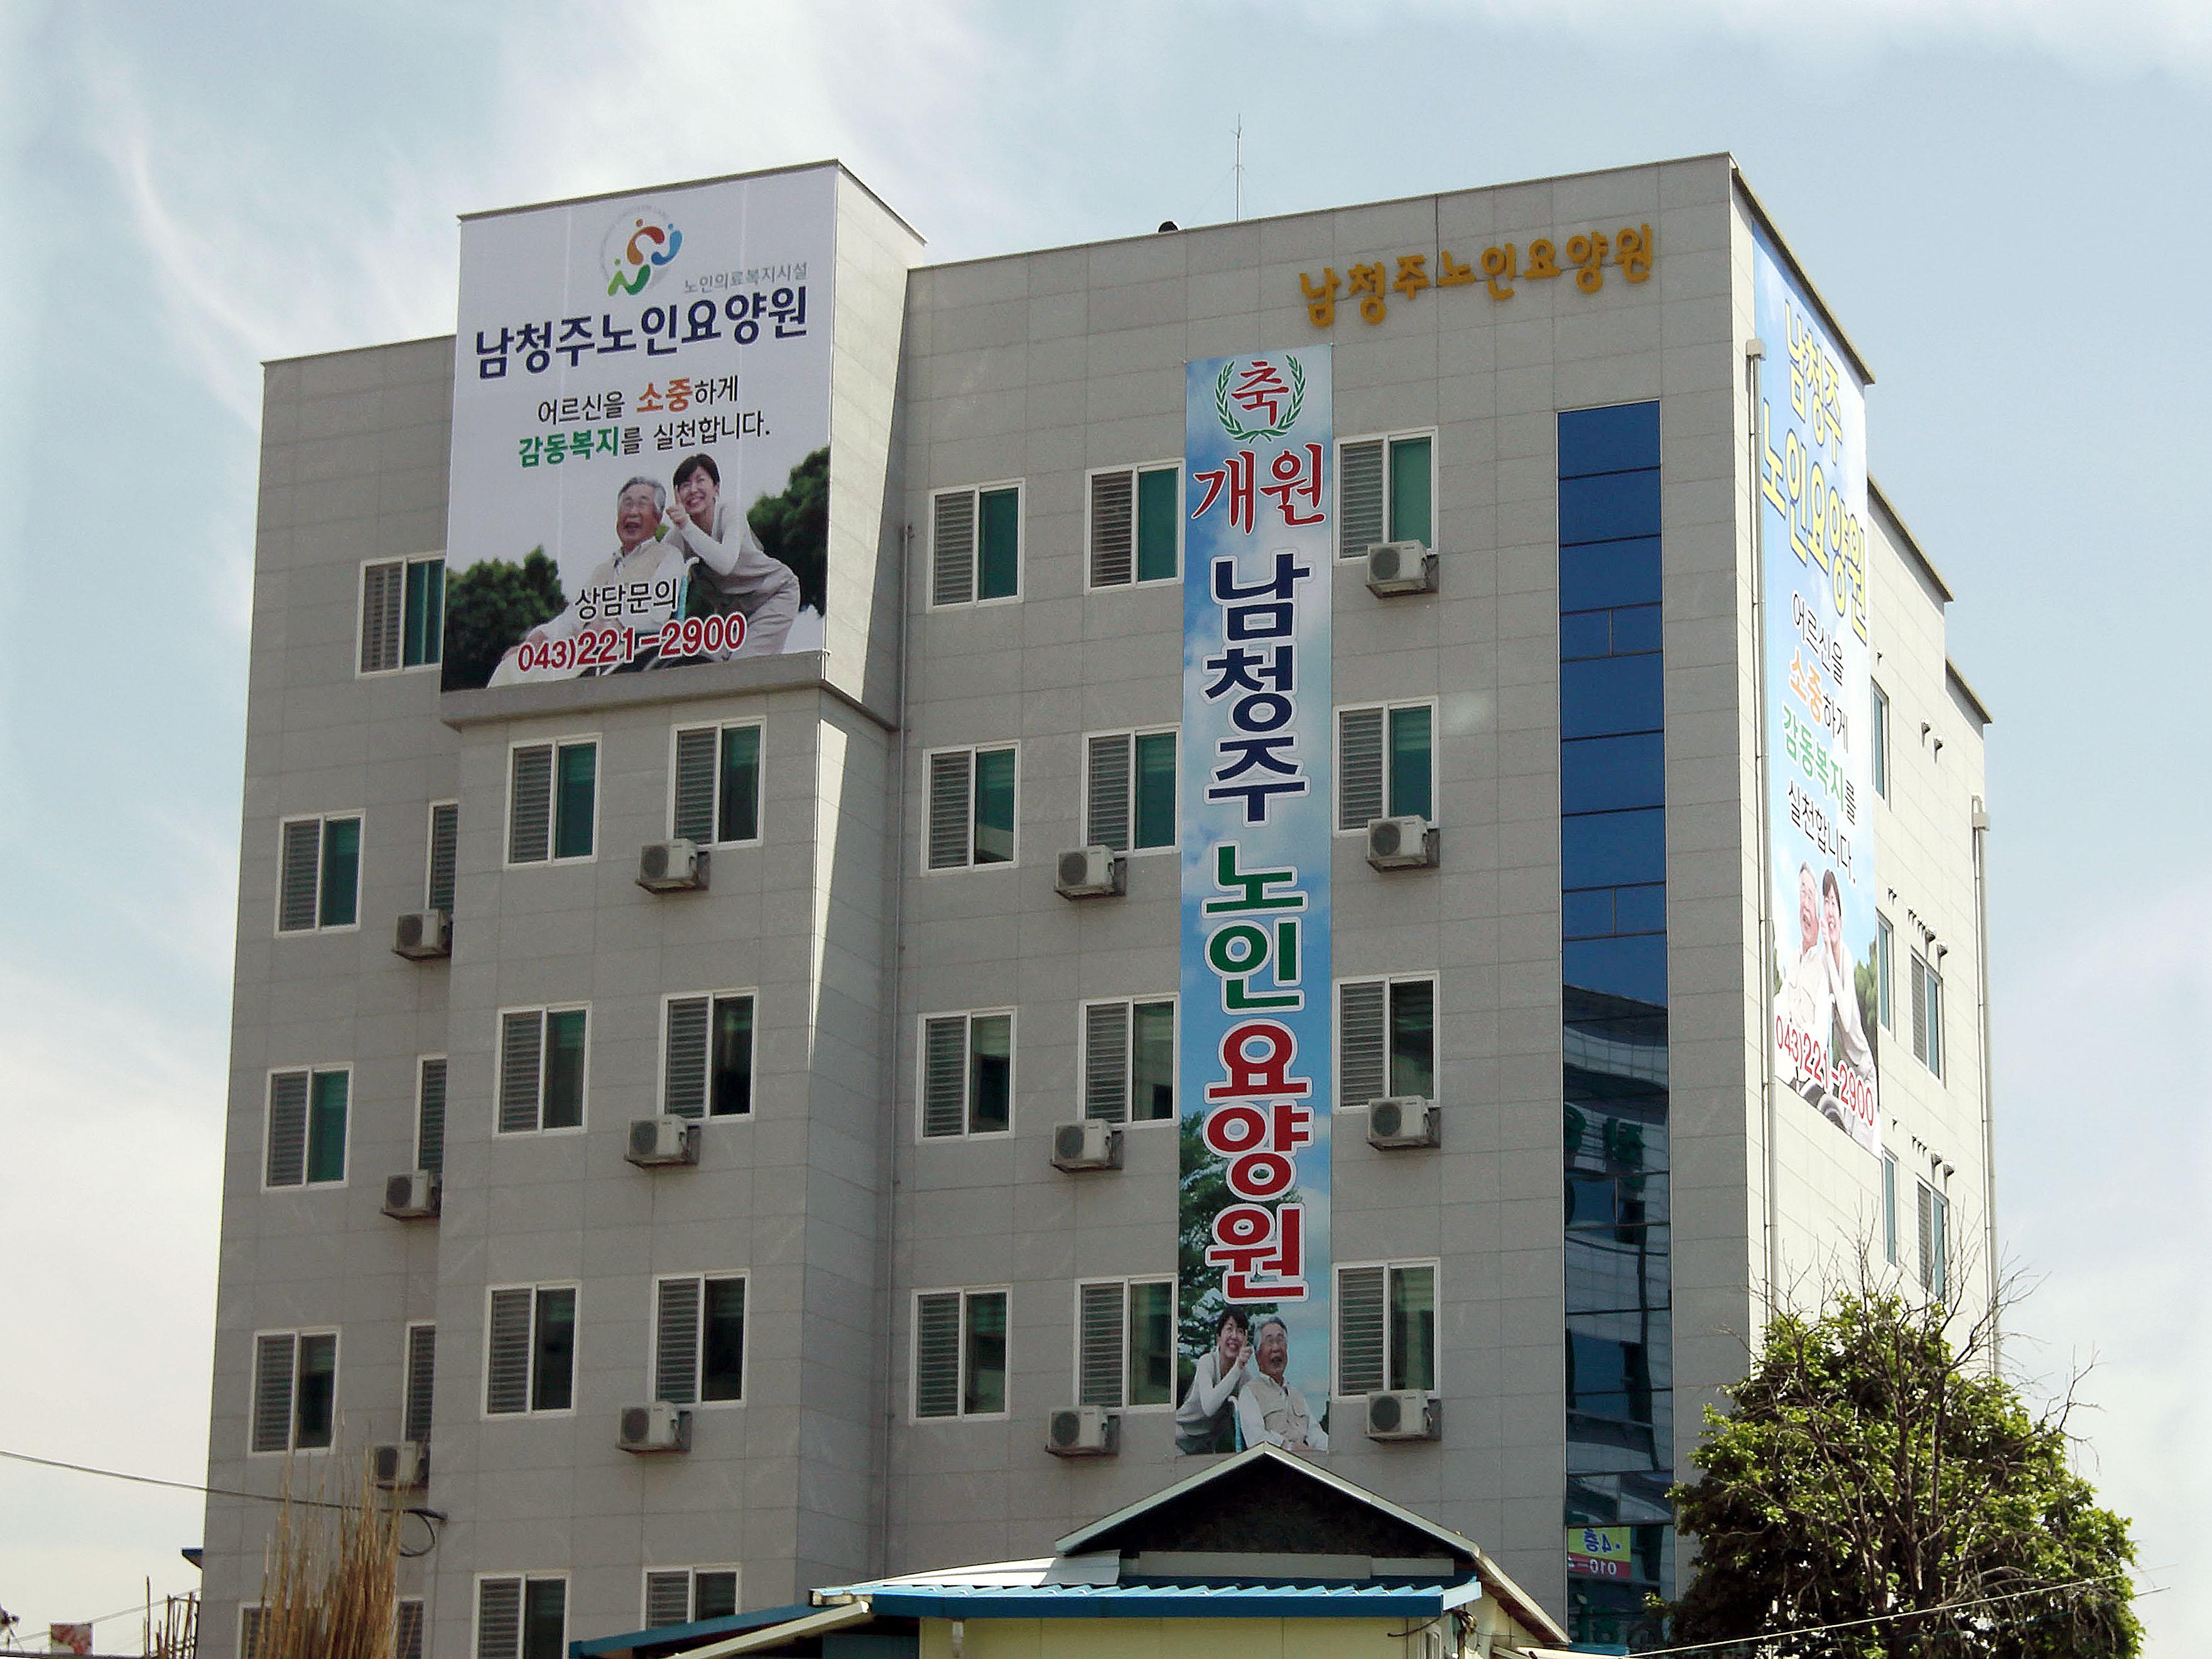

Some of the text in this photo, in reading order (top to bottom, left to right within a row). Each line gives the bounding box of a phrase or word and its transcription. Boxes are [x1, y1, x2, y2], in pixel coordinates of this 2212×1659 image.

[683, 261, 808, 295] 노인의료복지시설
[1299, 223, 1654, 328] 남청주노인요양원
[475, 285, 808, 379] 남청주노인요양원
[538, 374, 739, 426] 어르신을 소중하게
[1230, 360, 1291, 426] 축
[1785, 298, 1845, 467] 남청주
[518, 409, 771, 468] 감동복지를 실천합니다.
[1191, 443, 1326, 535] 개원
[1762, 397, 1868, 647] 노인요양원
[518, 613, 747, 673] 043)221-2900
[574, 578, 678, 620] 상담문의
[1792, 593, 1845, 687] 어르신을
[1204, 553, 1311, 823] 남청주
[1789, 649, 1849, 754] 소중하게
[1781, 705, 1857, 826] 감동복지를
[1788, 780, 1857, 885] 실천합니다.
[1776, 1015, 1875, 1127] 043)221-2900
